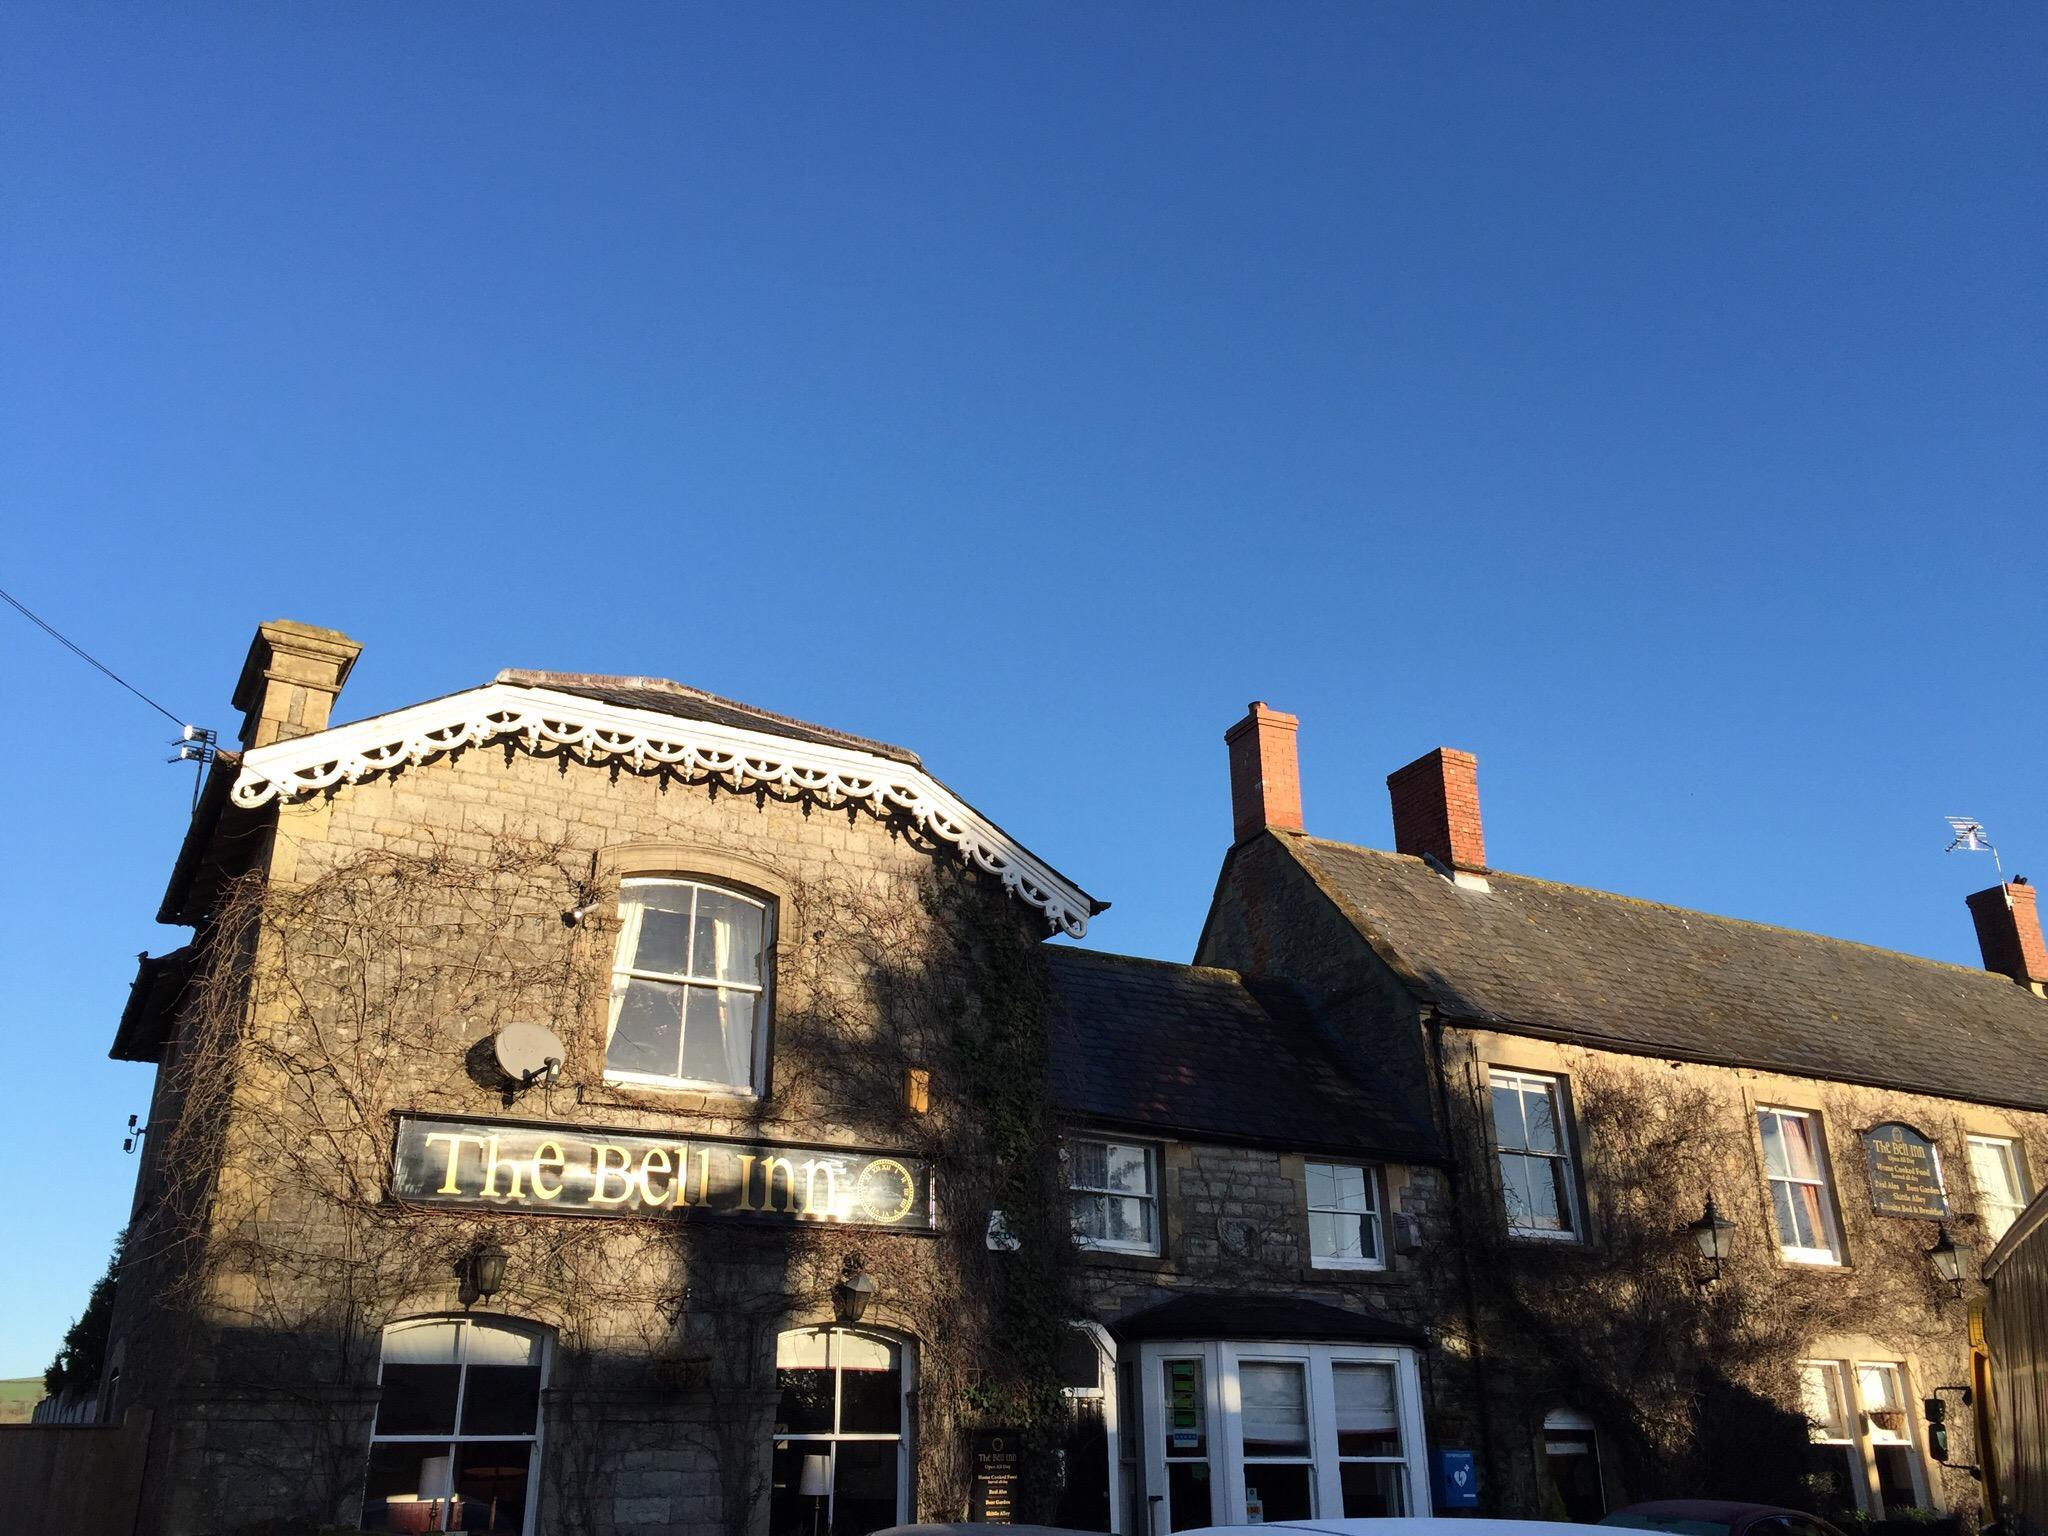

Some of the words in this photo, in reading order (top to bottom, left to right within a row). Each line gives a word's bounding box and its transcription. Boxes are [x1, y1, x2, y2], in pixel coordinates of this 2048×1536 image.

[425, 1132, 566, 1200] The
[588, 1143, 713, 1208] Bell
[736, 1153, 847, 1217] Inn
[1873, 1140, 1891, 1154] The
[1892, 1142, 1909, 1156] Bell
[1910, 1144, 1926, 1159] Inn
